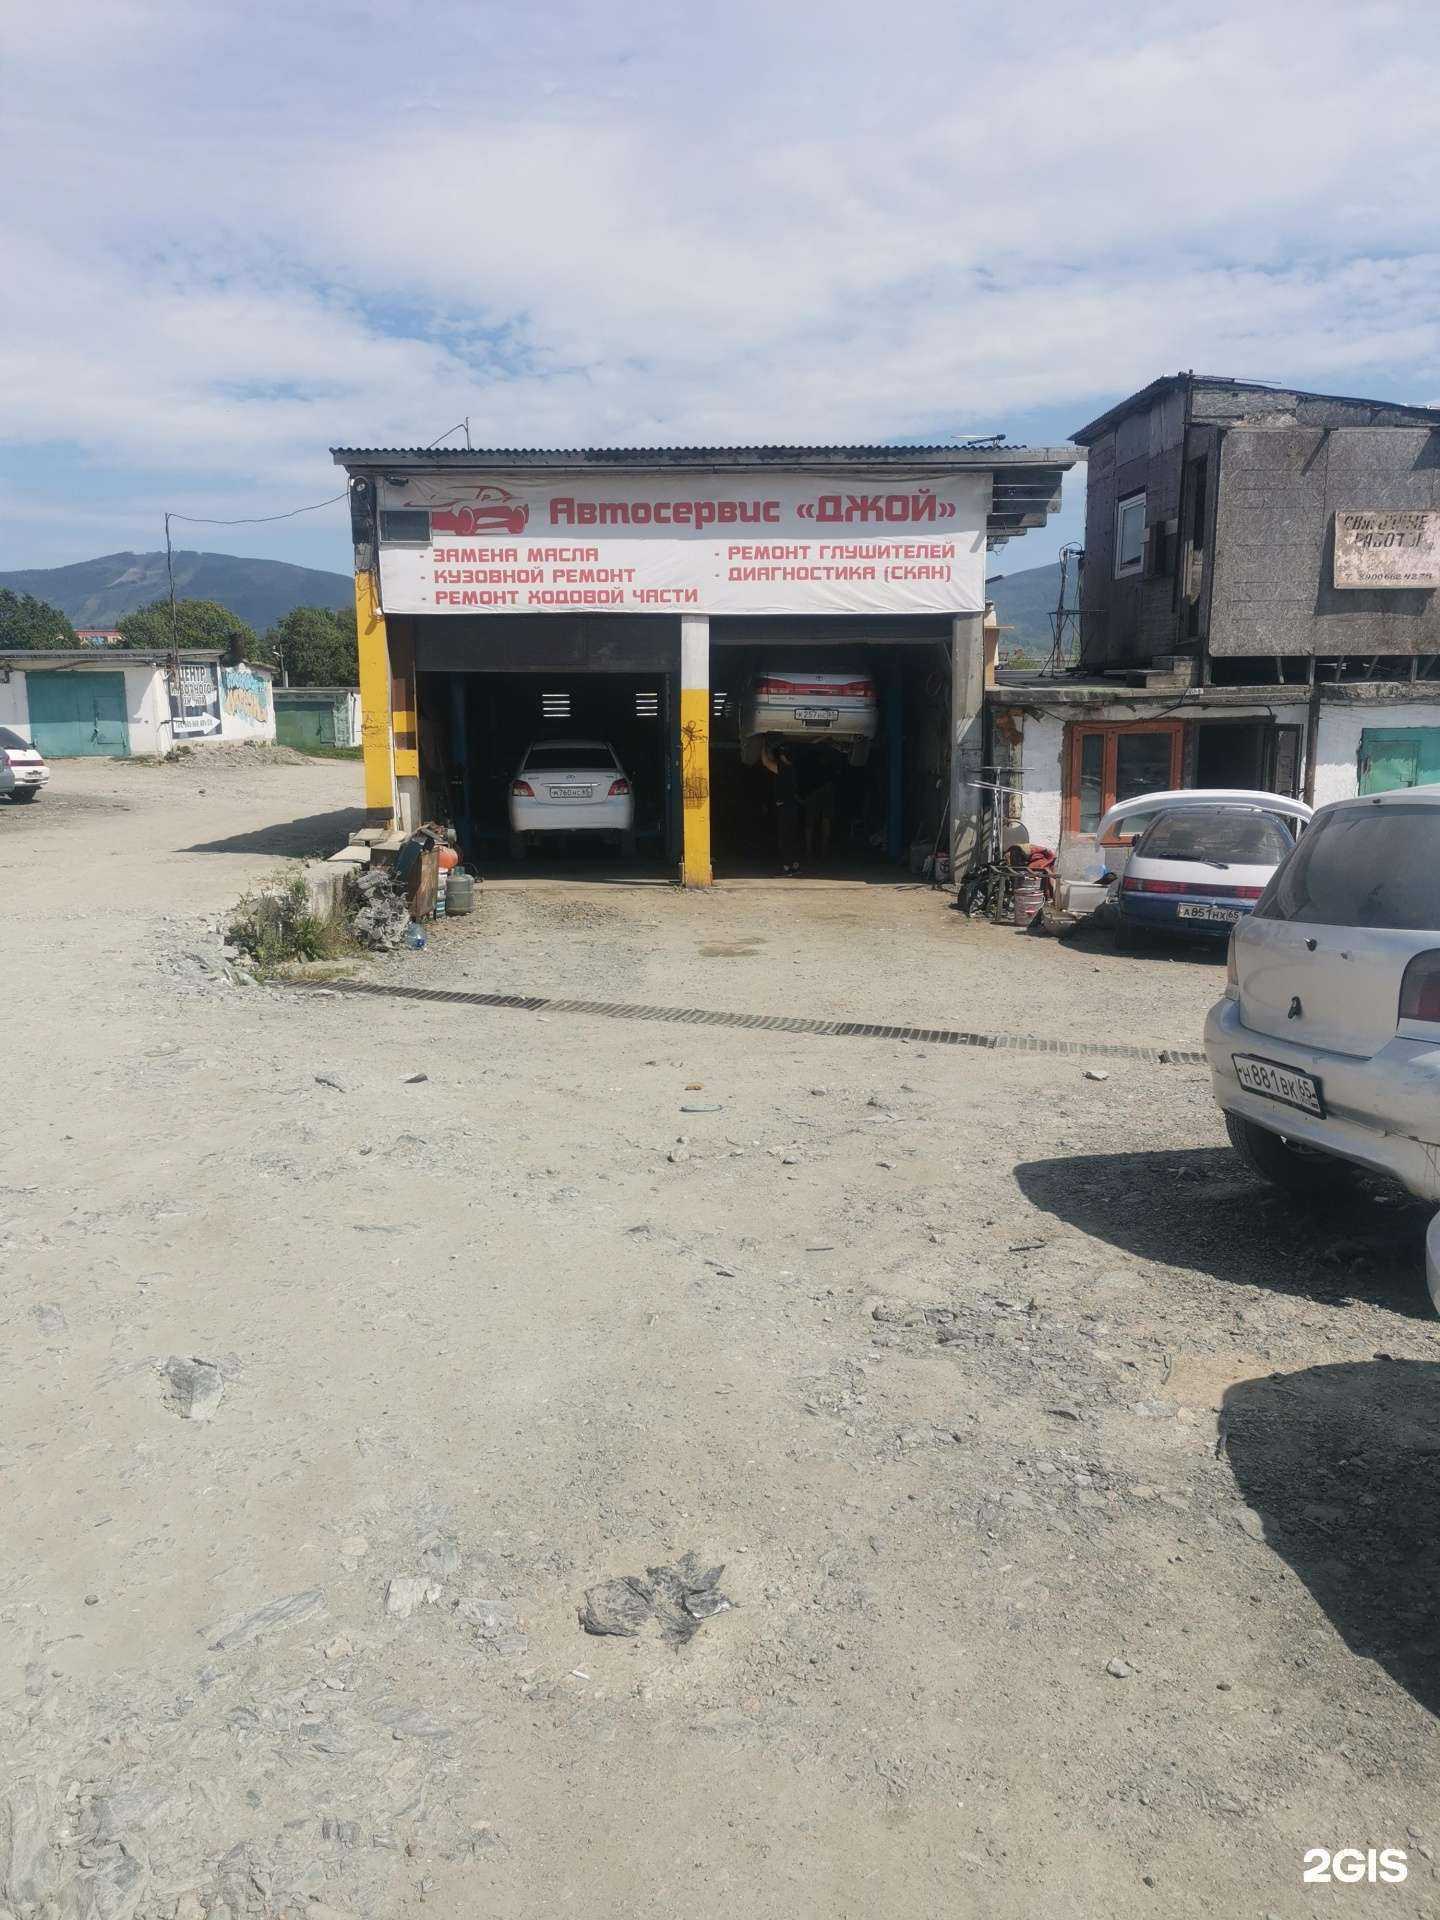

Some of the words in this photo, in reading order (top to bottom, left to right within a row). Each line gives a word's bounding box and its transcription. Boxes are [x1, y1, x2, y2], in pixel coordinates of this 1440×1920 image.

[550, 498, 781, 530] Автосервис
[796, 488, 956, 523] «ДЖОЙ»
[433, 548, 518, 563] ЗАМЕНА
[527, 547, 599, 562] МАСЛА
[728, 545, 811, 560] РЕМОНТ
[819, 541, 956, 560] ГЛУШИТЕЛЕЙ
[434, 566, 545, 584] КУЗОВНОЙ
[552, 568, 636, 583] РЕМОНТ
[728, 566, 876, 582] ДИАГНОСТИКА
[884, 565, 952, 583] (СКАН)
[435, 590, 520, 605] РЕМОНТ
[528, 586, 625, 605] ХОДОВОЙ
[633, 588, 699, 604] ЧАСТИ
